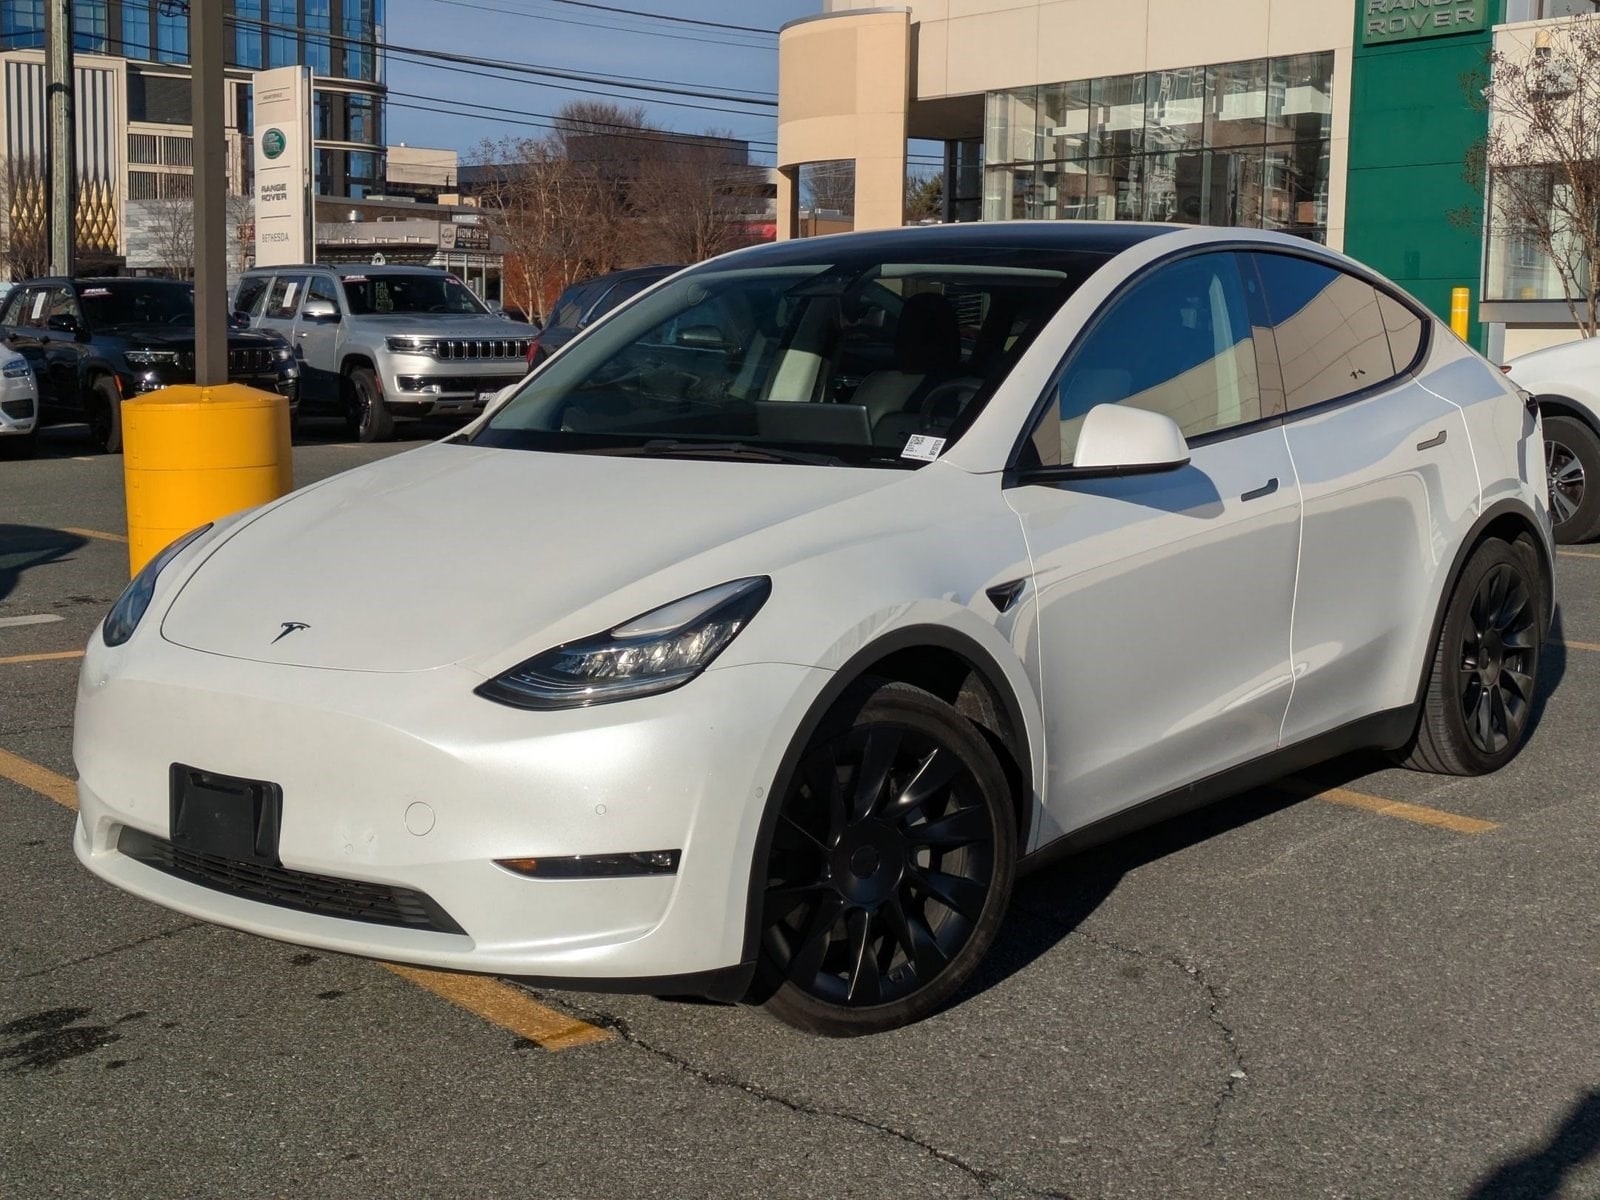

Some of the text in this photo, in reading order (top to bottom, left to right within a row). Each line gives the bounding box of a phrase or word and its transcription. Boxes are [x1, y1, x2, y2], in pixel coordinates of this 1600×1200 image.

[1367, 7, 1475, 37] ROVER
[260, 183, 287, 193] RANGE
[260, 192, 287, 202] ROVER
[261, 232, 289, 243] BETHESDA
